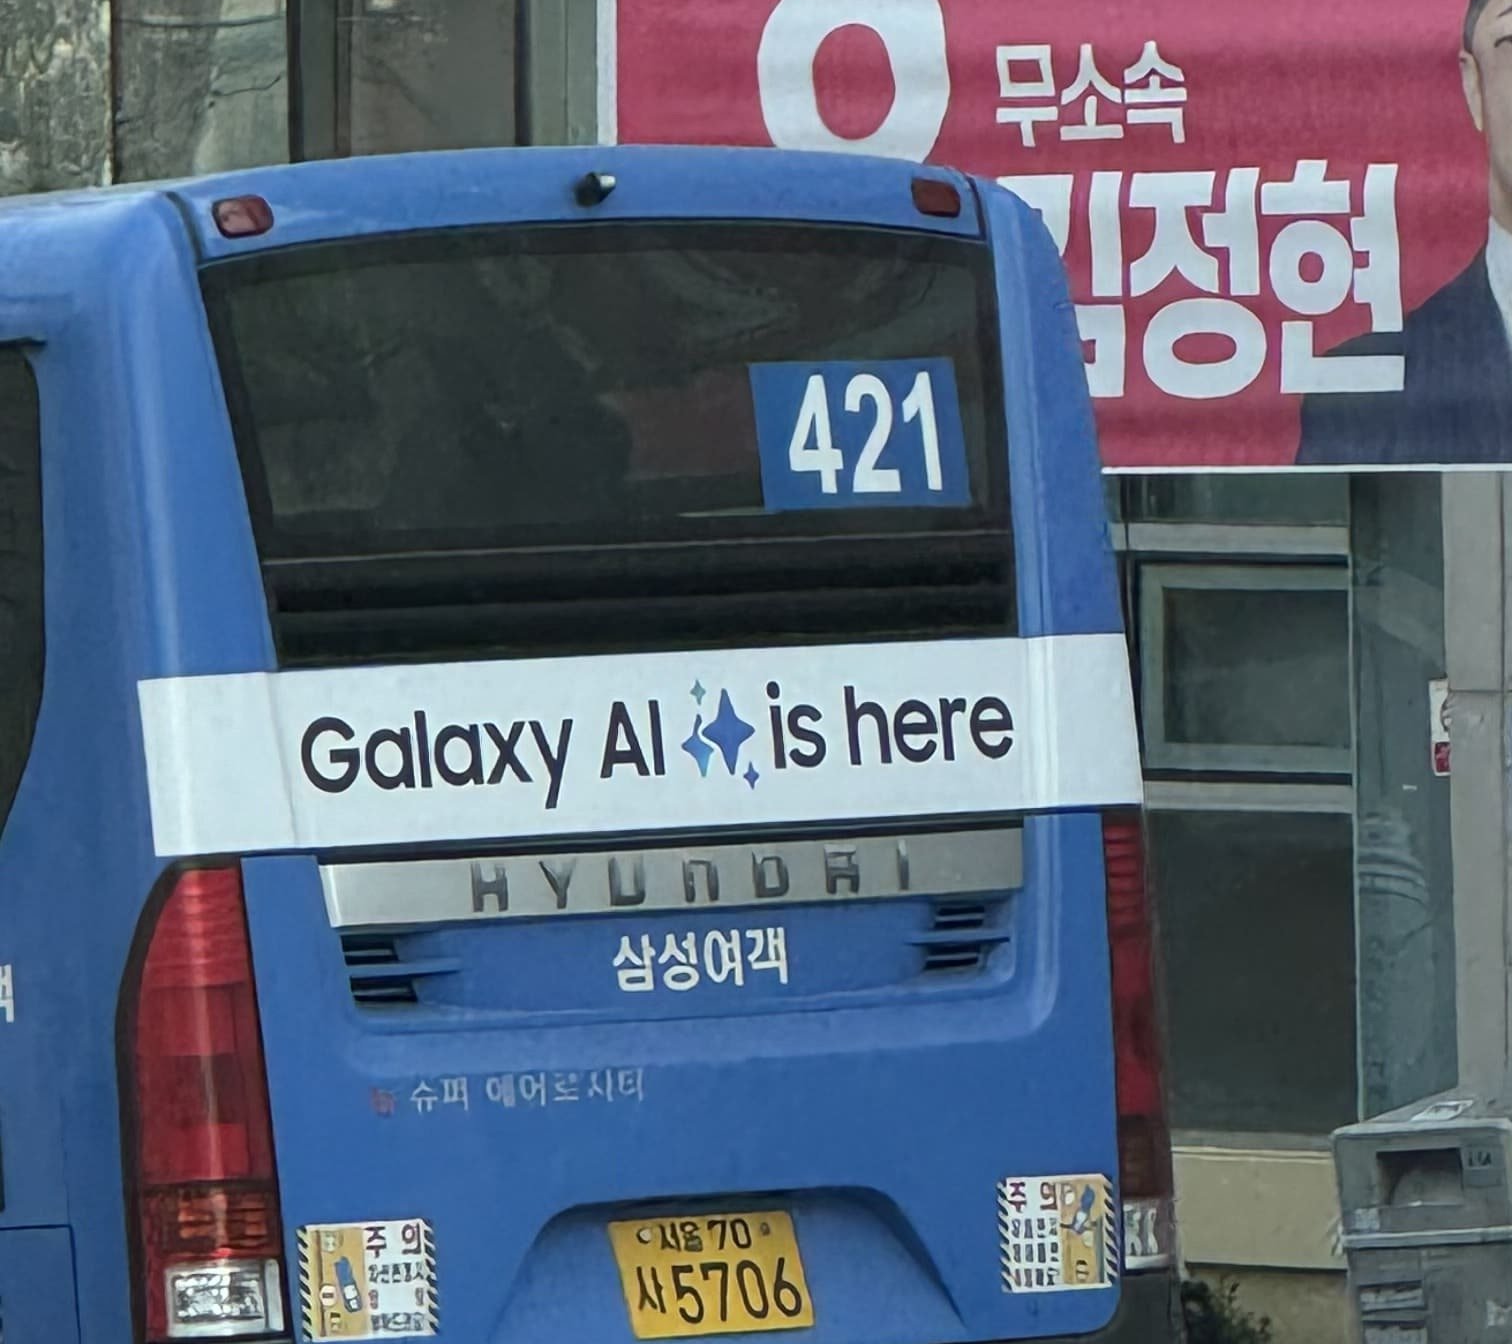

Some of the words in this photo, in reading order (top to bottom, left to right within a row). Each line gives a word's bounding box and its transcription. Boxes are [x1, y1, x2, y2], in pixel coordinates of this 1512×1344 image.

[994, 39, 1188, 149] 무소속
[788, 371, 943, 494] 421
[301, 711, 573, 809] Galaxy
[600, 699, 666, 779] AI
[766, 681, 826, 770] is
[843, 686, 1014, 766] here
[470, 840, 911, 913] HYUNDAI
[612, 927, 789, 993] 삼성여객
[409, 1078, 469, 1113] 슈퍼
